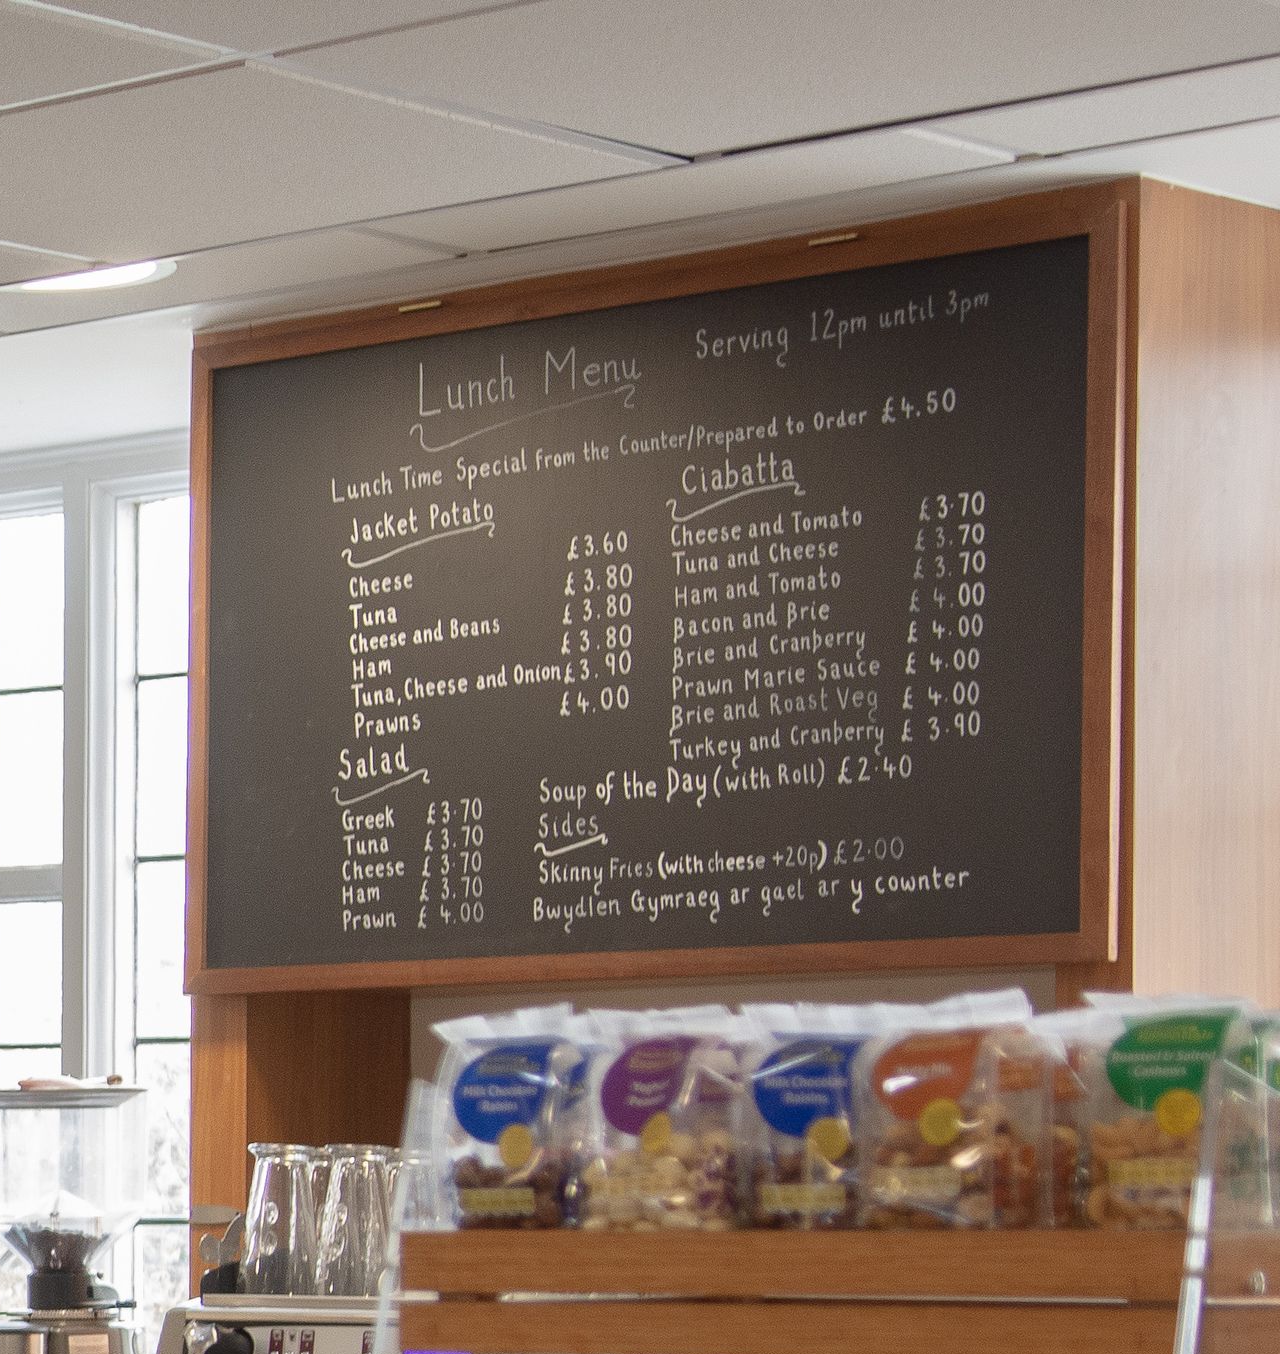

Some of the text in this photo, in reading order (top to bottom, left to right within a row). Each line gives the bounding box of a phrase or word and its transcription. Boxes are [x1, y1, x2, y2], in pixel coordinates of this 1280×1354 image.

[696, 289, 991, 368] Serving 12pm until 3pm
[419, 347, 642, 416] Lunch Menu
[332, 388, 956, 503] Lunch Time Special from the Counter/Prepared to Order £4.50
[682, 452, 795, 495] Ciabatta
[351, 498, 493, 544] Jacket Potato
[671, 523, 741, 547] Cheese
[748, 517, 783, 538] and
[791, 505, 863, 533] Tomato
[672, 551, 719, 577] Tuna
[728, 544, 760, 568] and
[770, 541, 839, 562] Cheese
[349, 571, 413, 598] Cheese
[675, 584, 718, 608] Ham
[726, 573, 759, 598] and
[769, 565, 841, 593] Tomato
[349, 603, 397, 629] Tuna
[350, 632, 406, 655] Cheese
[413, 621, 443, 645] and
[451, 616, 500, 638] Beans
[674, 616, 733, 643] Bacon
[743, 605, 776, 630] and
[787, 602, 830, 627] Brie
[352, 659, 391, 680] Ham
[673, 646, 715, 674] Brie
[725, 637, 758, 661] and
[770, 628, 866, 660] Cranberry
[404, 674, 468, 699] Cheese
[476, 665, 507, 688] and
[514, 664, 561, 686] Onion
[672, 675, 733, 699] Prawn
[745, 666, 806, 689] Marie
[818, 659, 880, 680] Sauce
[355, 712, 421, 738] Prawns
[670, 705, 714, 735] Brie
[723, 695, 759, 720] and
[770, 692, 828, 716] Roast
[838, 687, 878, 723] Veg
[339, 743, 409, 780] Salad
[671, 736, 741, 768] Turkey
[750, 727, 781, 753] and
[791, 720, 884, 755] Cranberry
[540, 778, 586, 809] Soup
[596, 772, 615, 805] of
[623, 770, 657, 799] the
[778, 757, 826, 790] Roll)
[838, 754, 912, 785] £2.40
[342, 805, 395, 830] Greek
[539, 813, 598, 839] Sides
[344, 835, 389, 856] Tuna
[540, 836, 905, 895] Skinny Fries (with cheese +20p) £2.00
[342, 858, 405, 883] Cheese
[342, 885, 380, 905] Ham
[534, 867, 970, 933] Bwydlen Gymraeg ar gael ar y cownter
[343, 908, 396, 931] Prawn
